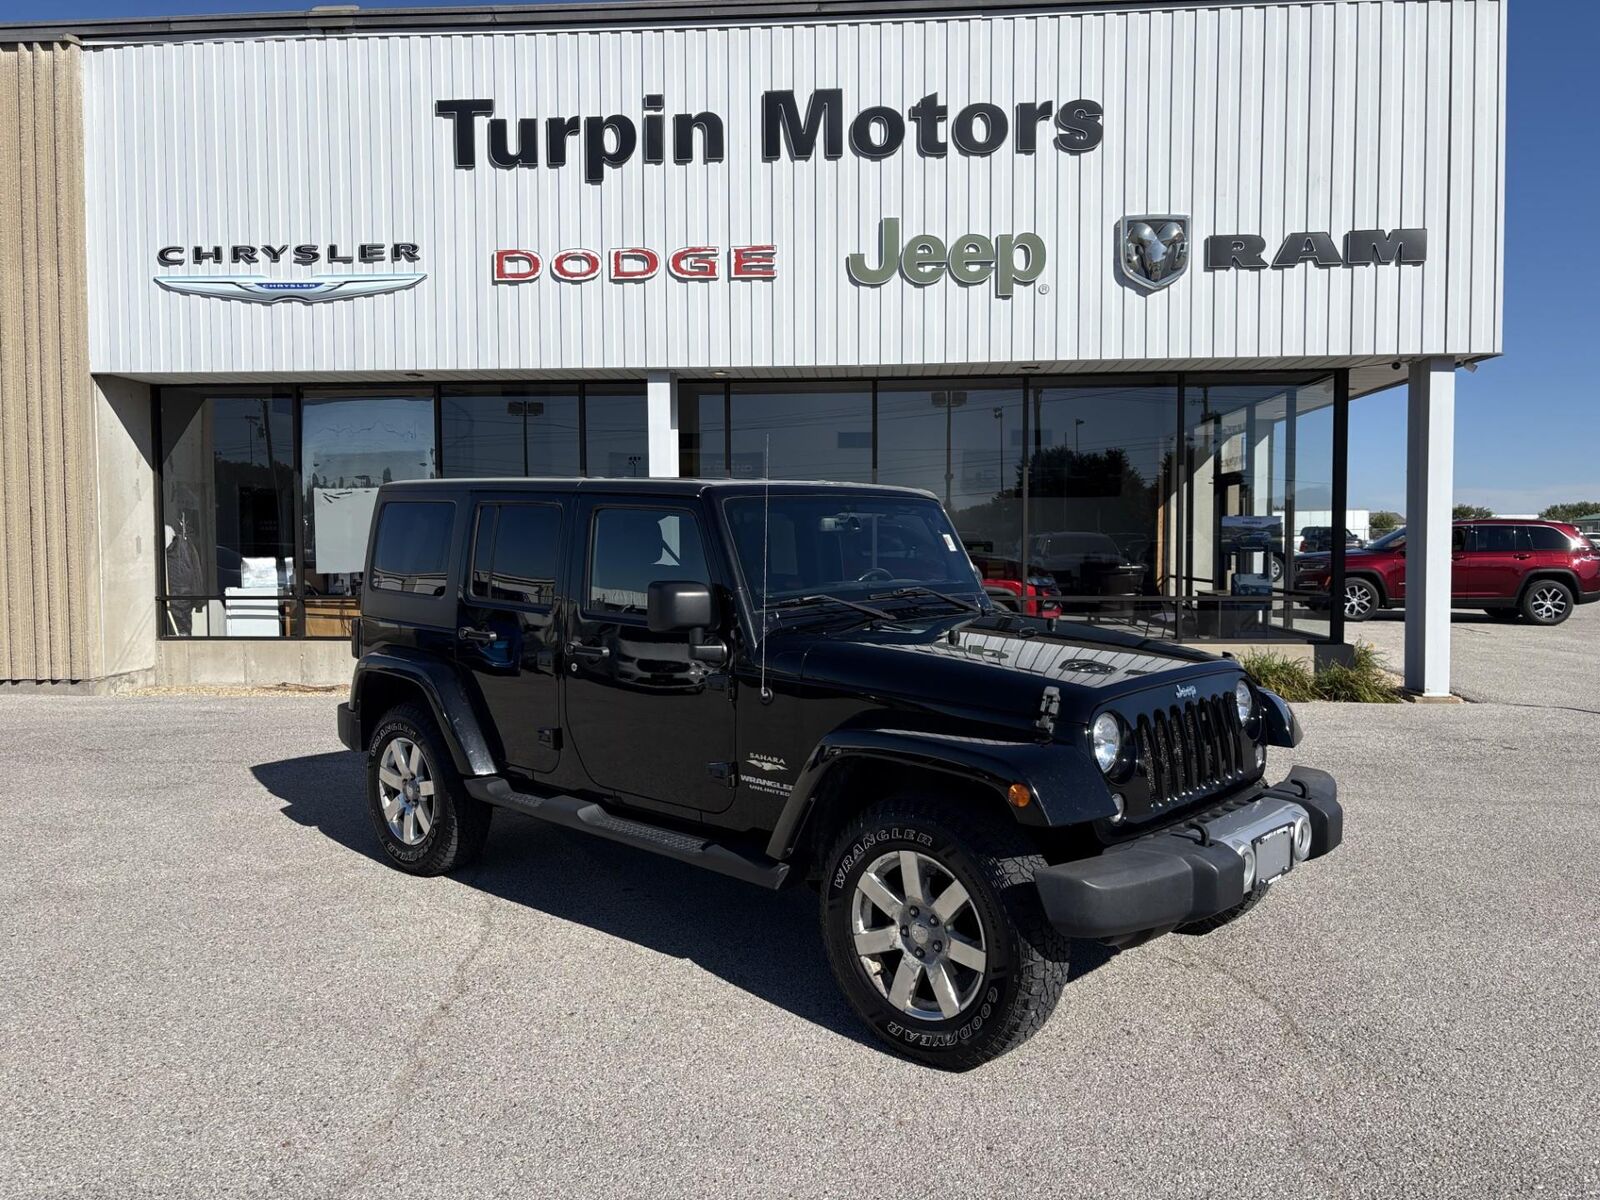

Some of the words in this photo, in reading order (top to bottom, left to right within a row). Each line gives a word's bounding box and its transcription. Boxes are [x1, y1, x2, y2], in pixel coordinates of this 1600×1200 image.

[435, 94, 724, 184] Turpin
[762, 88, 1103, 160] Motors
[155, 242, 421, 266] CHRYSLER
[492, 245, 778, 284] DODGE
[847, 217, 1047, 299] Jeep
[1205, 228, 1428, 271] RAM
[1175, 684, 1197, 698] Jeep
[749, 752, 786, 765] SAHARA
[748, 784, 791, 797] UNLIMITED
[834, 827, 934, 890] WRANGLER
[886, 985, 999, 1047] GOODYEAR
